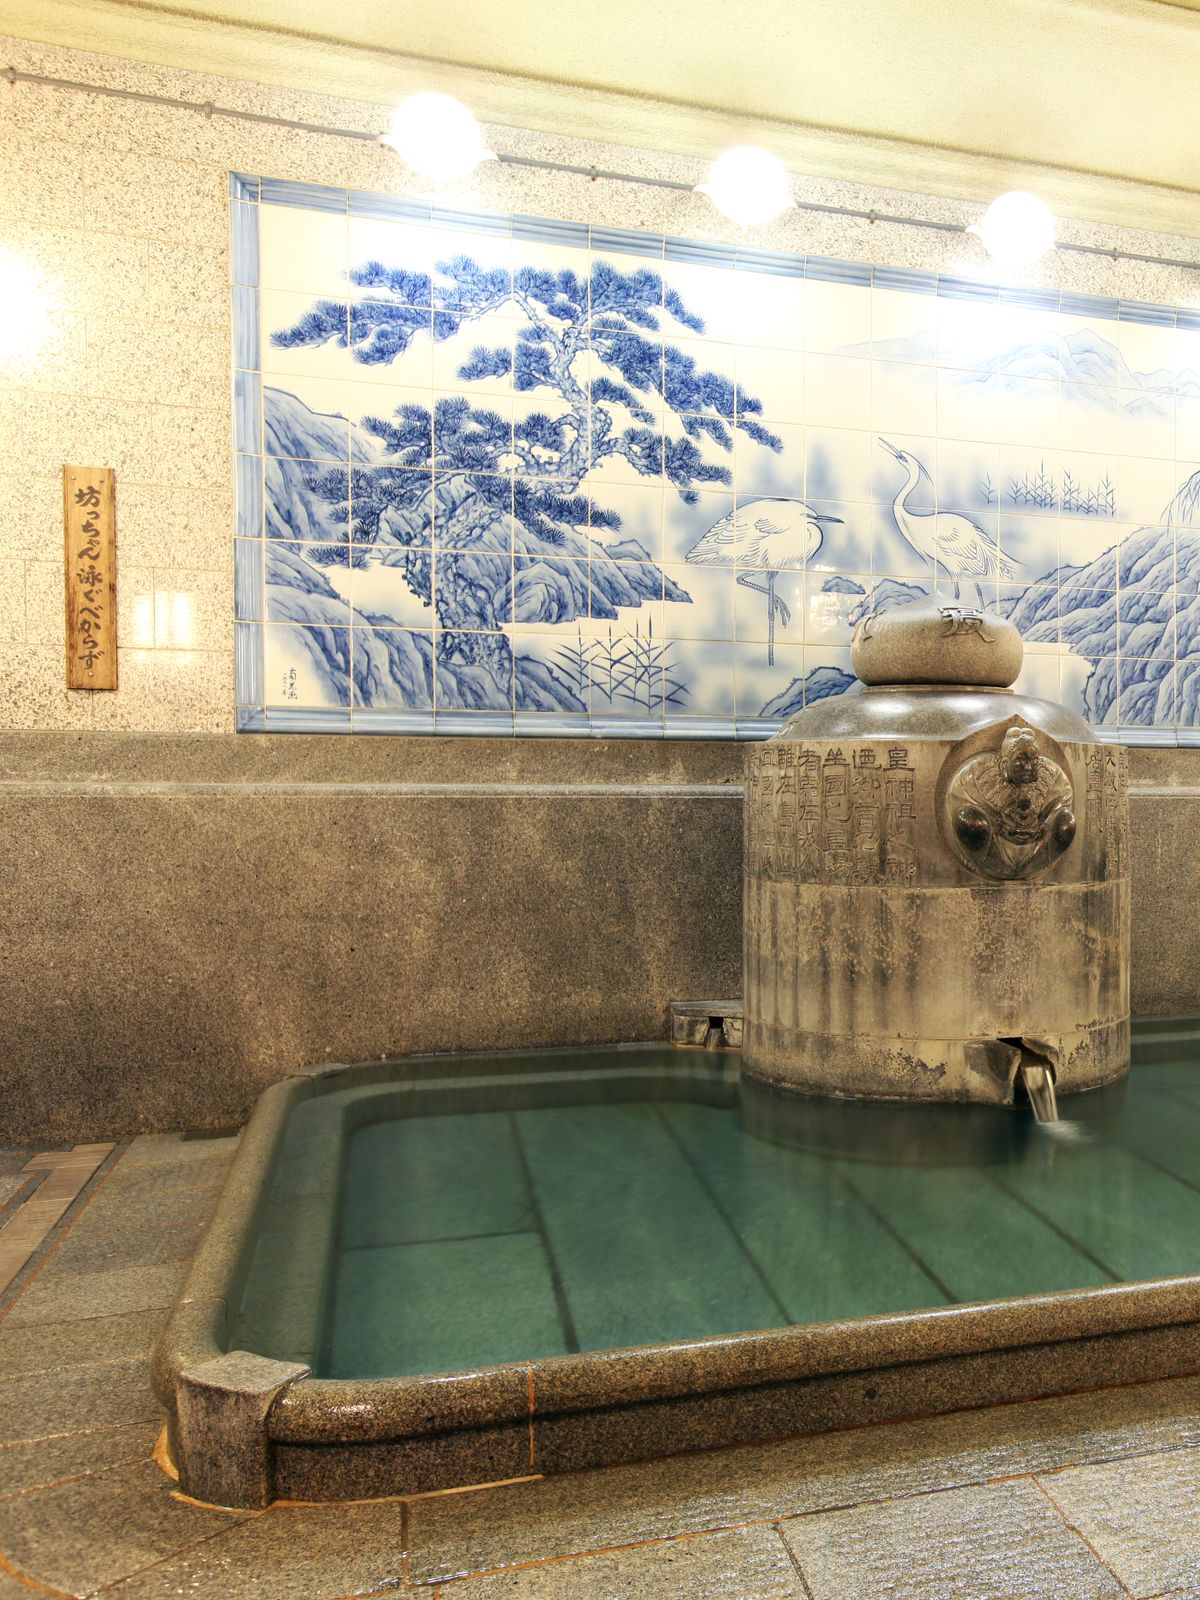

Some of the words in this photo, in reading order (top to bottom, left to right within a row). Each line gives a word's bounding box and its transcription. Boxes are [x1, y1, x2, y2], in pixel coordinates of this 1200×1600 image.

[74, 485, 104, 670] 坊っちゃん泳ぐべからず
